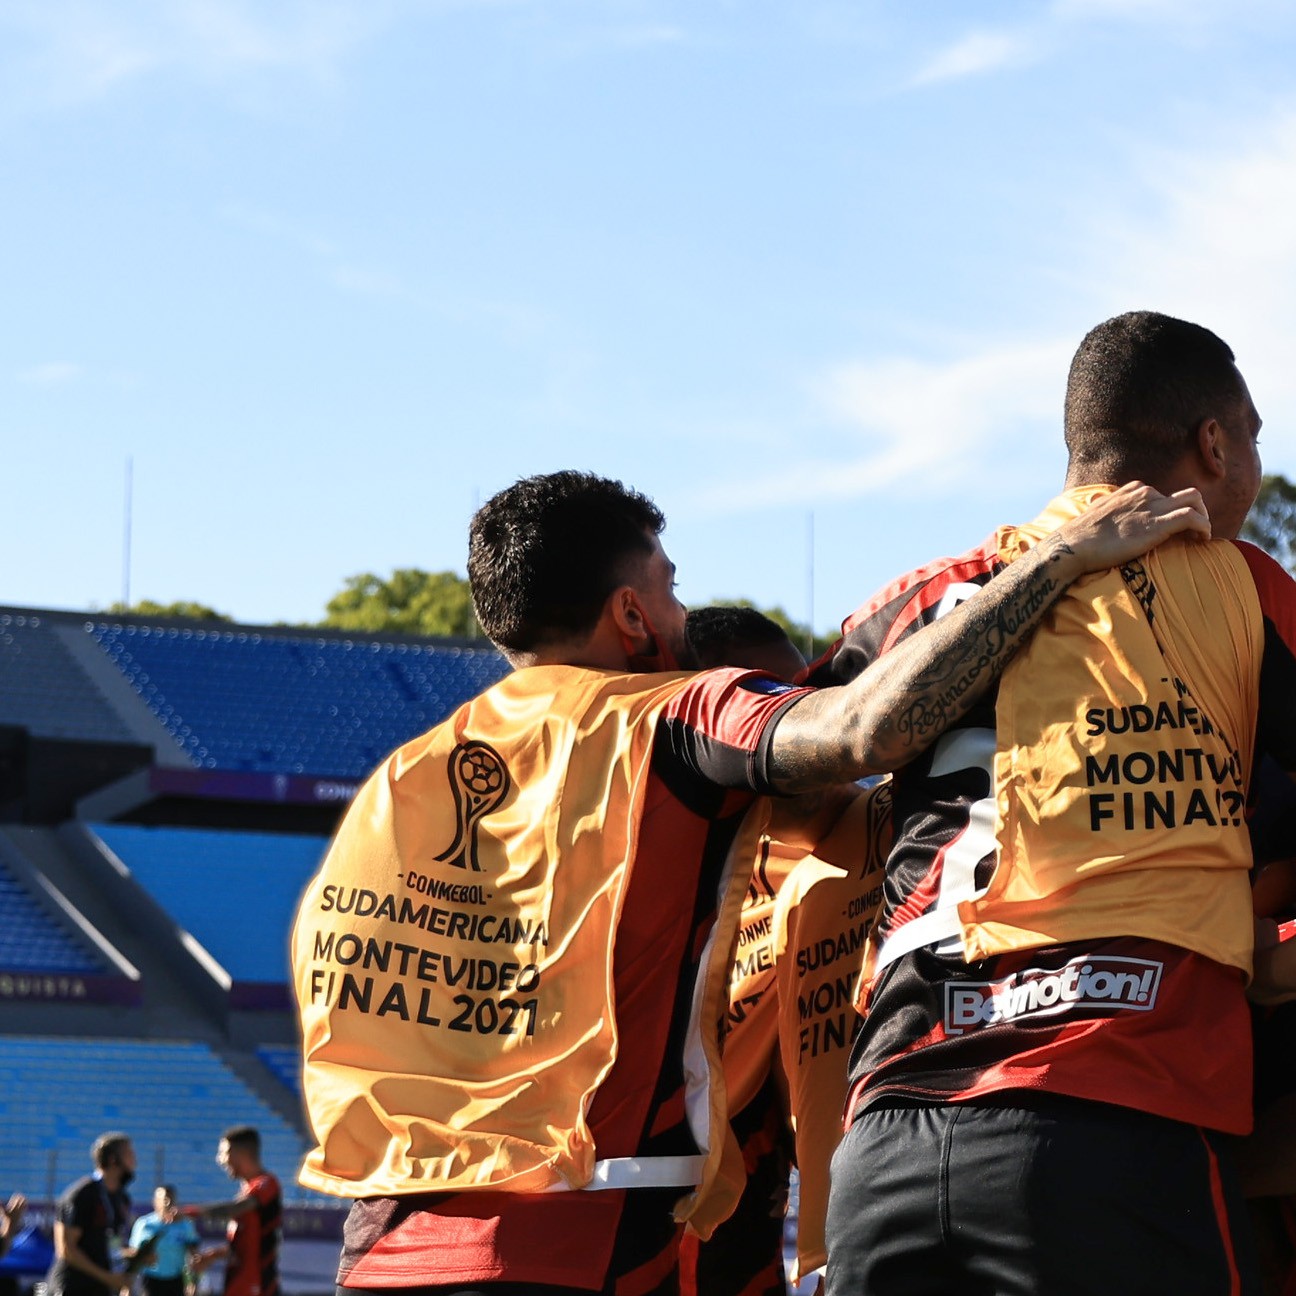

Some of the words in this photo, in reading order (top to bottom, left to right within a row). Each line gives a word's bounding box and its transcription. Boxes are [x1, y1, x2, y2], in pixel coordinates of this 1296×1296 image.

[320, 884, 549, 946] SUDAMERICANA
[312, 930, 541, 993] MONTEVIDEO
[311, 970, 441, 1027] FINAL
[448, 994, 538, 1036] 2021
